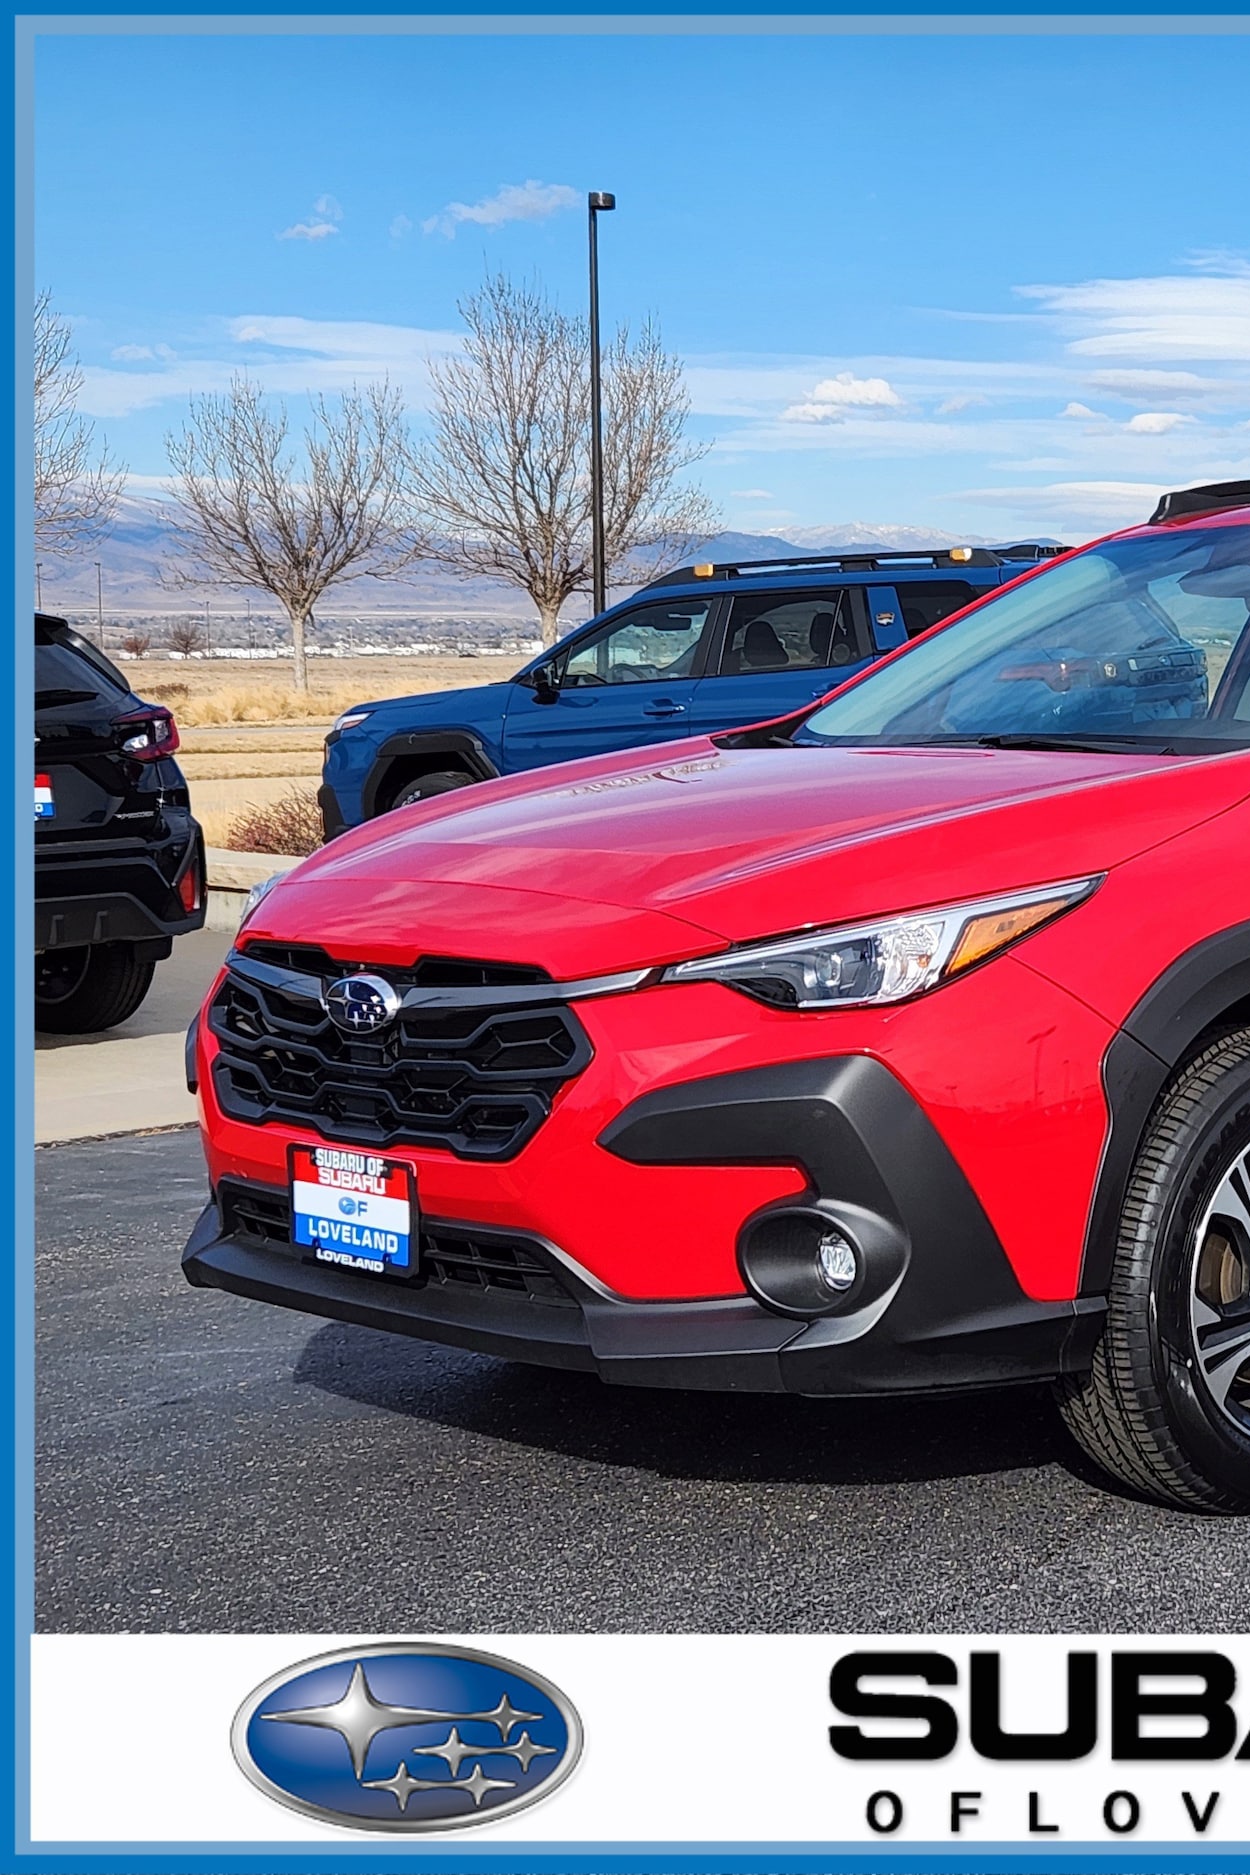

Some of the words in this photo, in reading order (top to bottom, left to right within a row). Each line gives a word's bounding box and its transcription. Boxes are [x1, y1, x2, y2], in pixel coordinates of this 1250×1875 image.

[315, 1148, 364, 1173] SUBARU
[366, 1155, 385, 1176] OF
[318, 1168, 386, 1194] SUBARU
[308, 1218, 399, 1254] LOVELAND
[316, 1249, 384, 1273] LOVELAND
